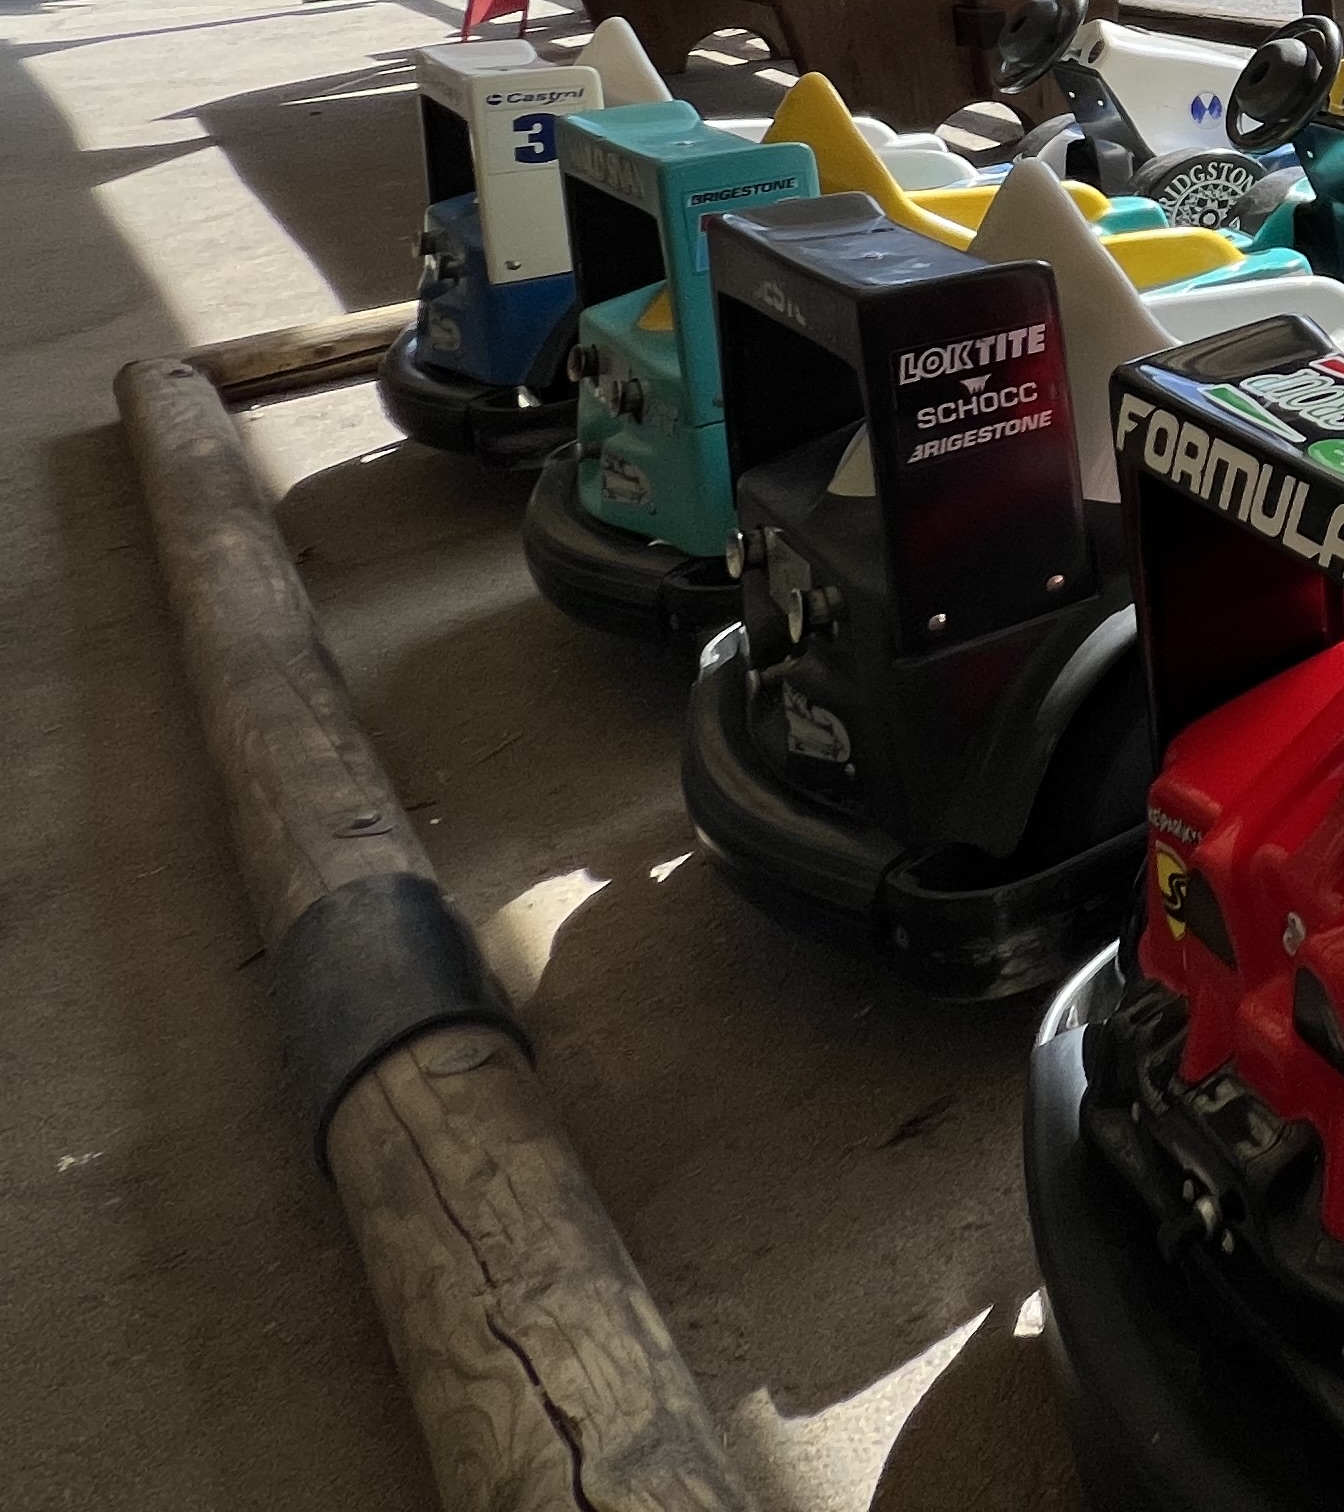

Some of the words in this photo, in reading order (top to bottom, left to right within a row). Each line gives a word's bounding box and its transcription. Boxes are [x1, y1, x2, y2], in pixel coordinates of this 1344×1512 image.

[512, 112, 559, 163] 3
[900, 324, 1046, 385] LOKTITE
[917, 382, 1038, 429] SCHOCC
